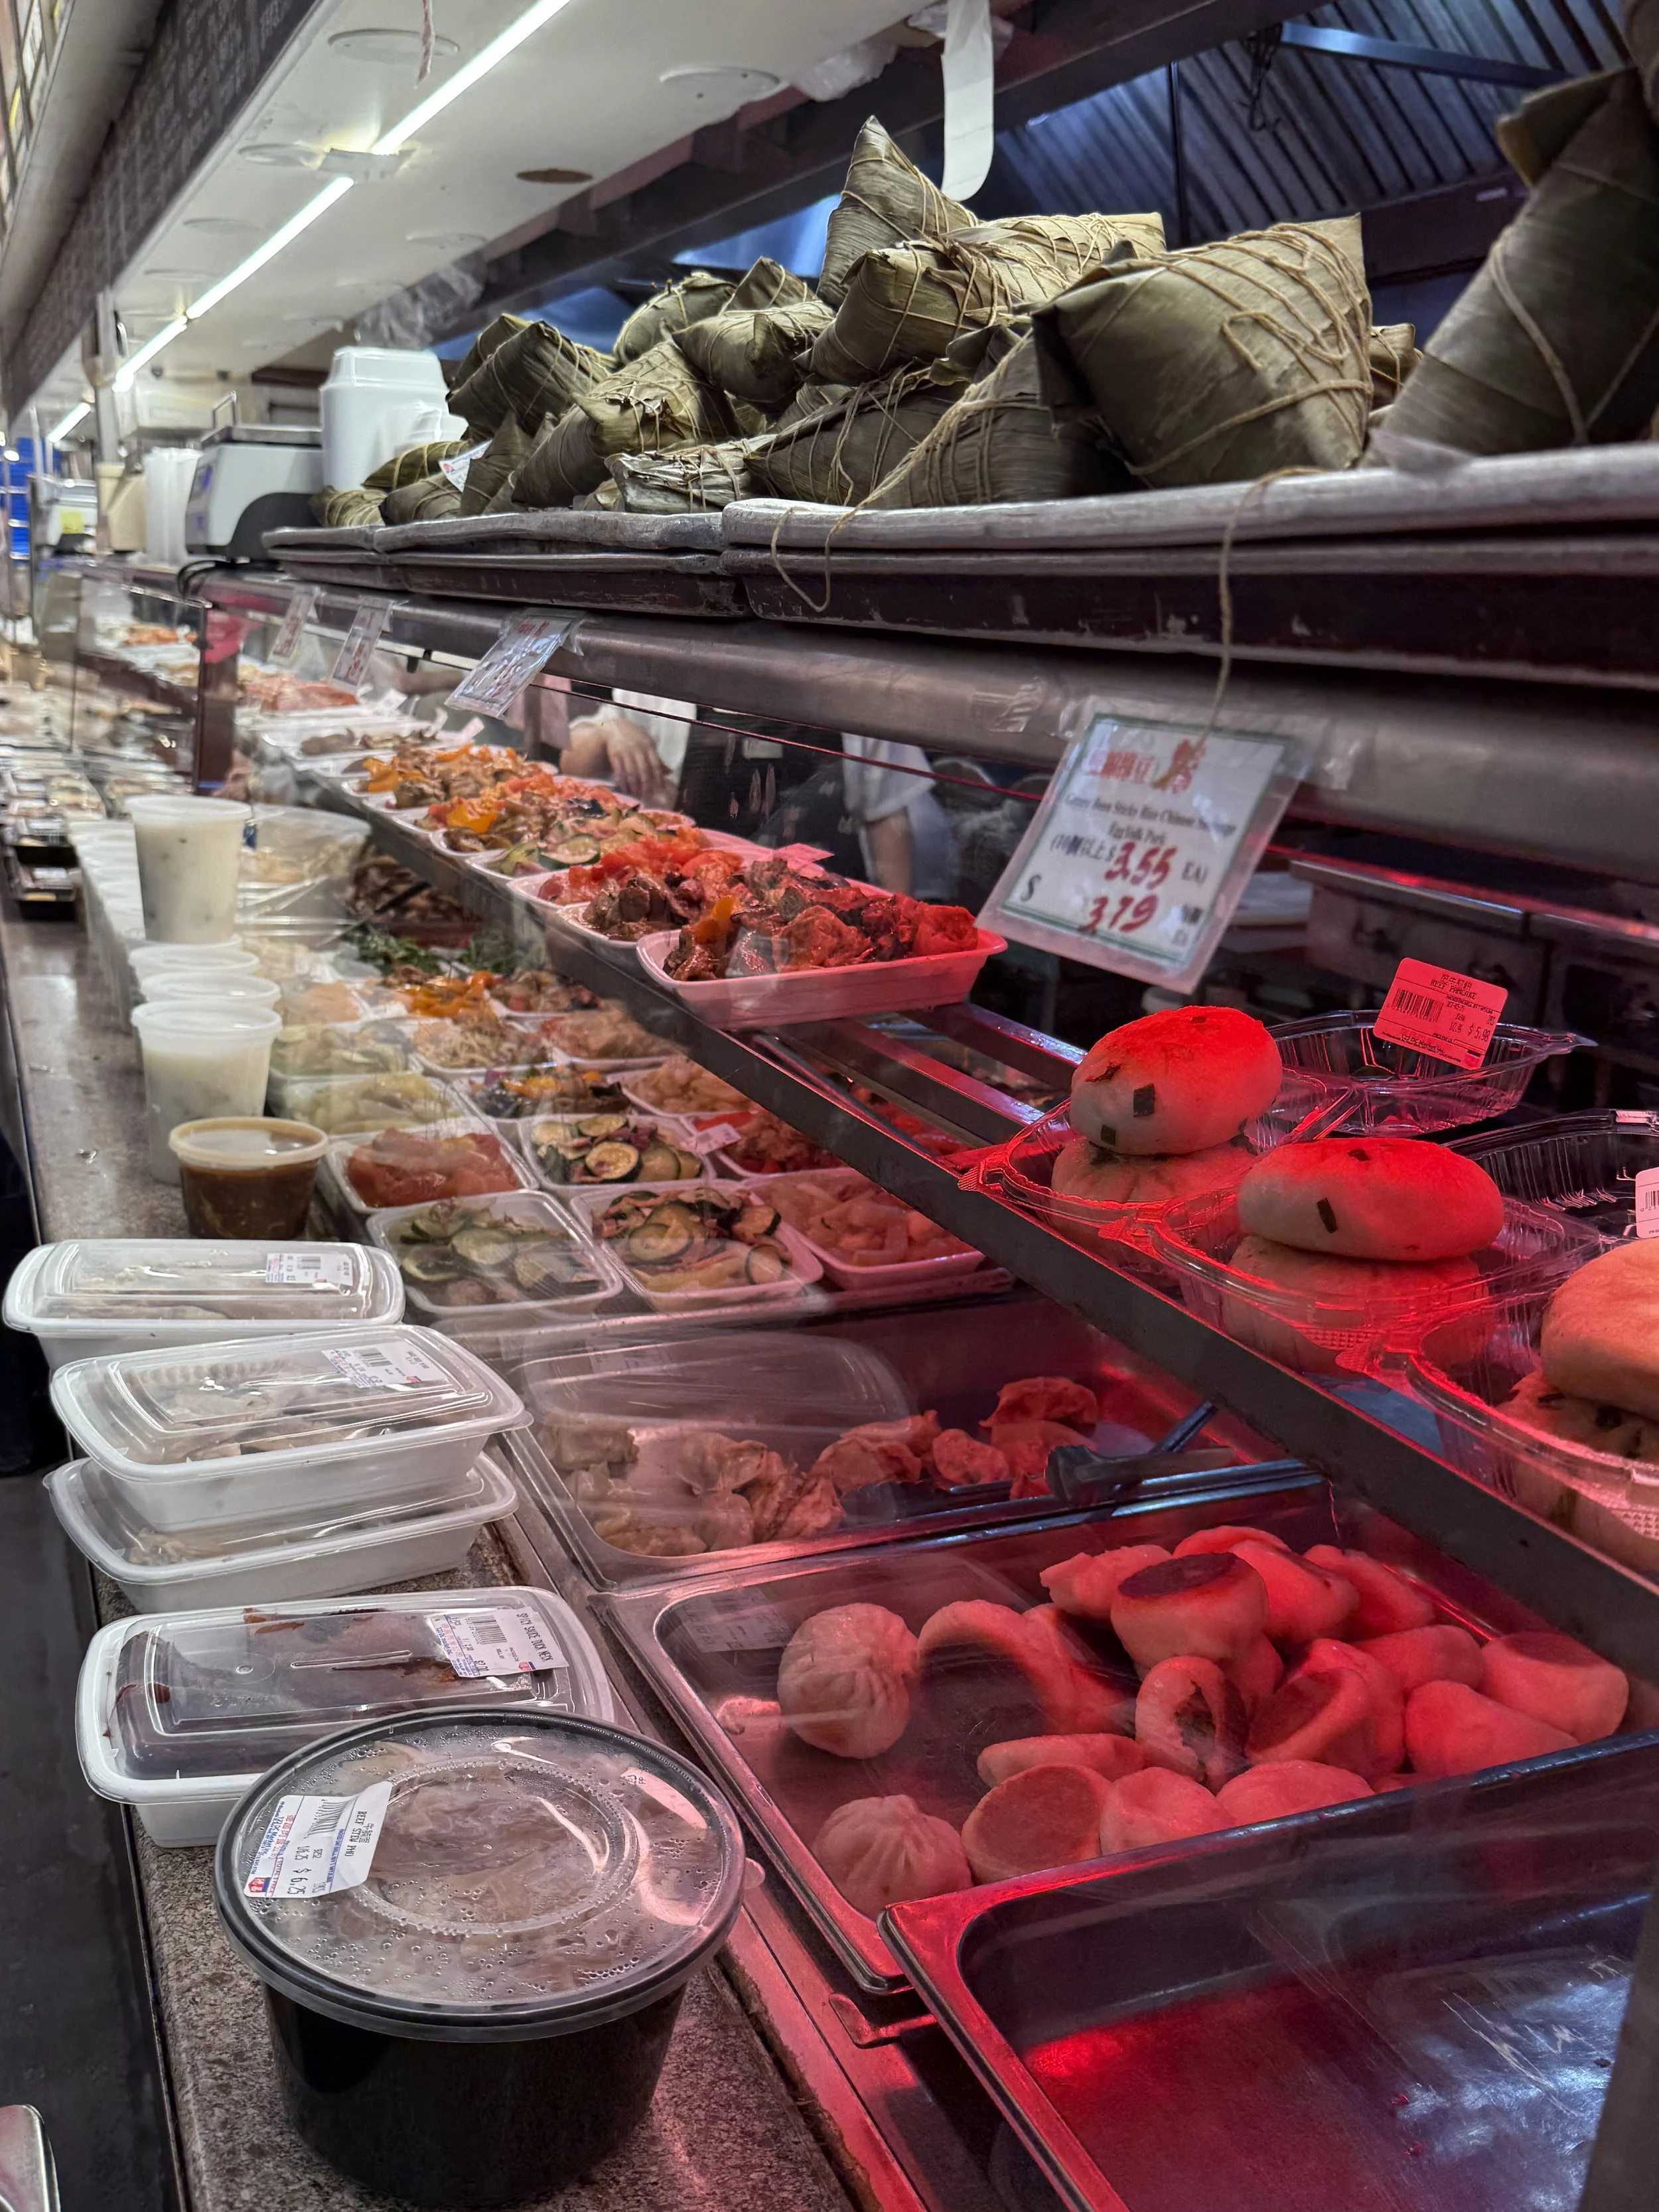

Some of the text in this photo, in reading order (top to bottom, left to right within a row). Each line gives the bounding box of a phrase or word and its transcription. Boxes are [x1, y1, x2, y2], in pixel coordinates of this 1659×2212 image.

[1467, 1023, 1491, 1042] $ 5.98
[517, 1613, 553, 1662] SPICY SAUCE DUCK NECK
[344, 1810, 367, 1857] BEEF STEW PHO
[287, 1877, 308, 1894] 6.25
